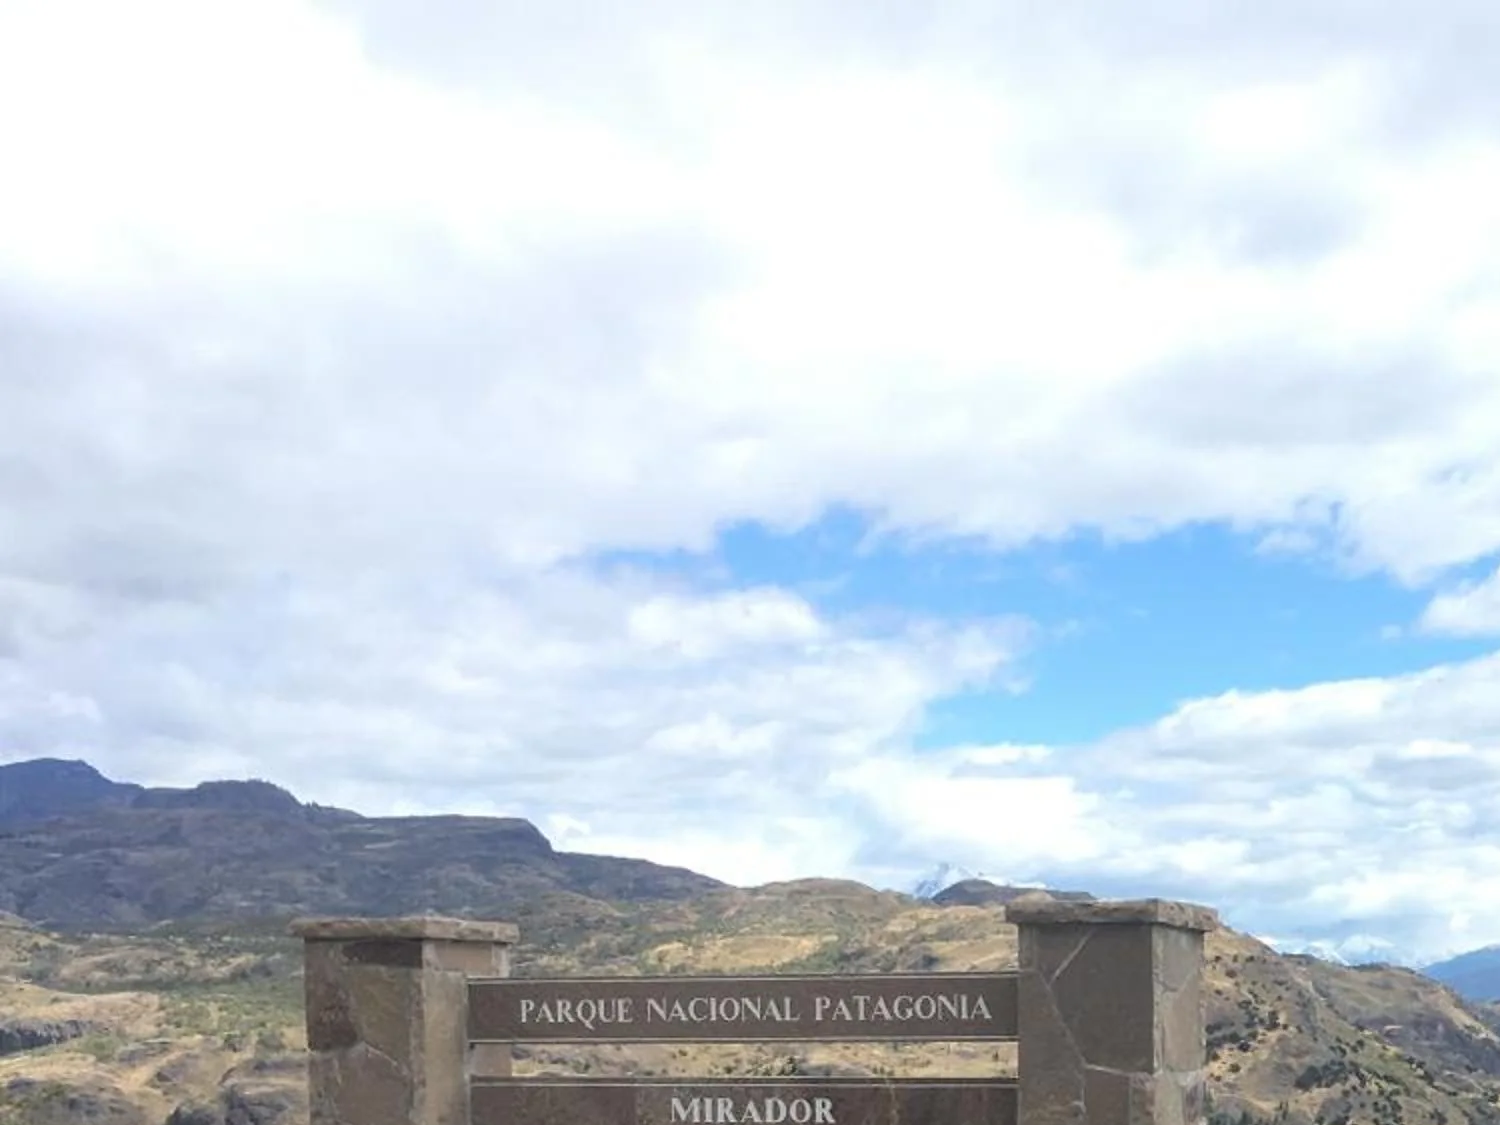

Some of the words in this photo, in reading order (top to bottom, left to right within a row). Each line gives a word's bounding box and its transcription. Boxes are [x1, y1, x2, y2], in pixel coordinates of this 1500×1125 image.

[520, 999, 634, 1030] PARQUE
[646, 997, 800, 1023] NACIONAL
[814, 994, 993, 1022] PATAGONIA
[671, 1097, 836, 1125] MIRADOR
